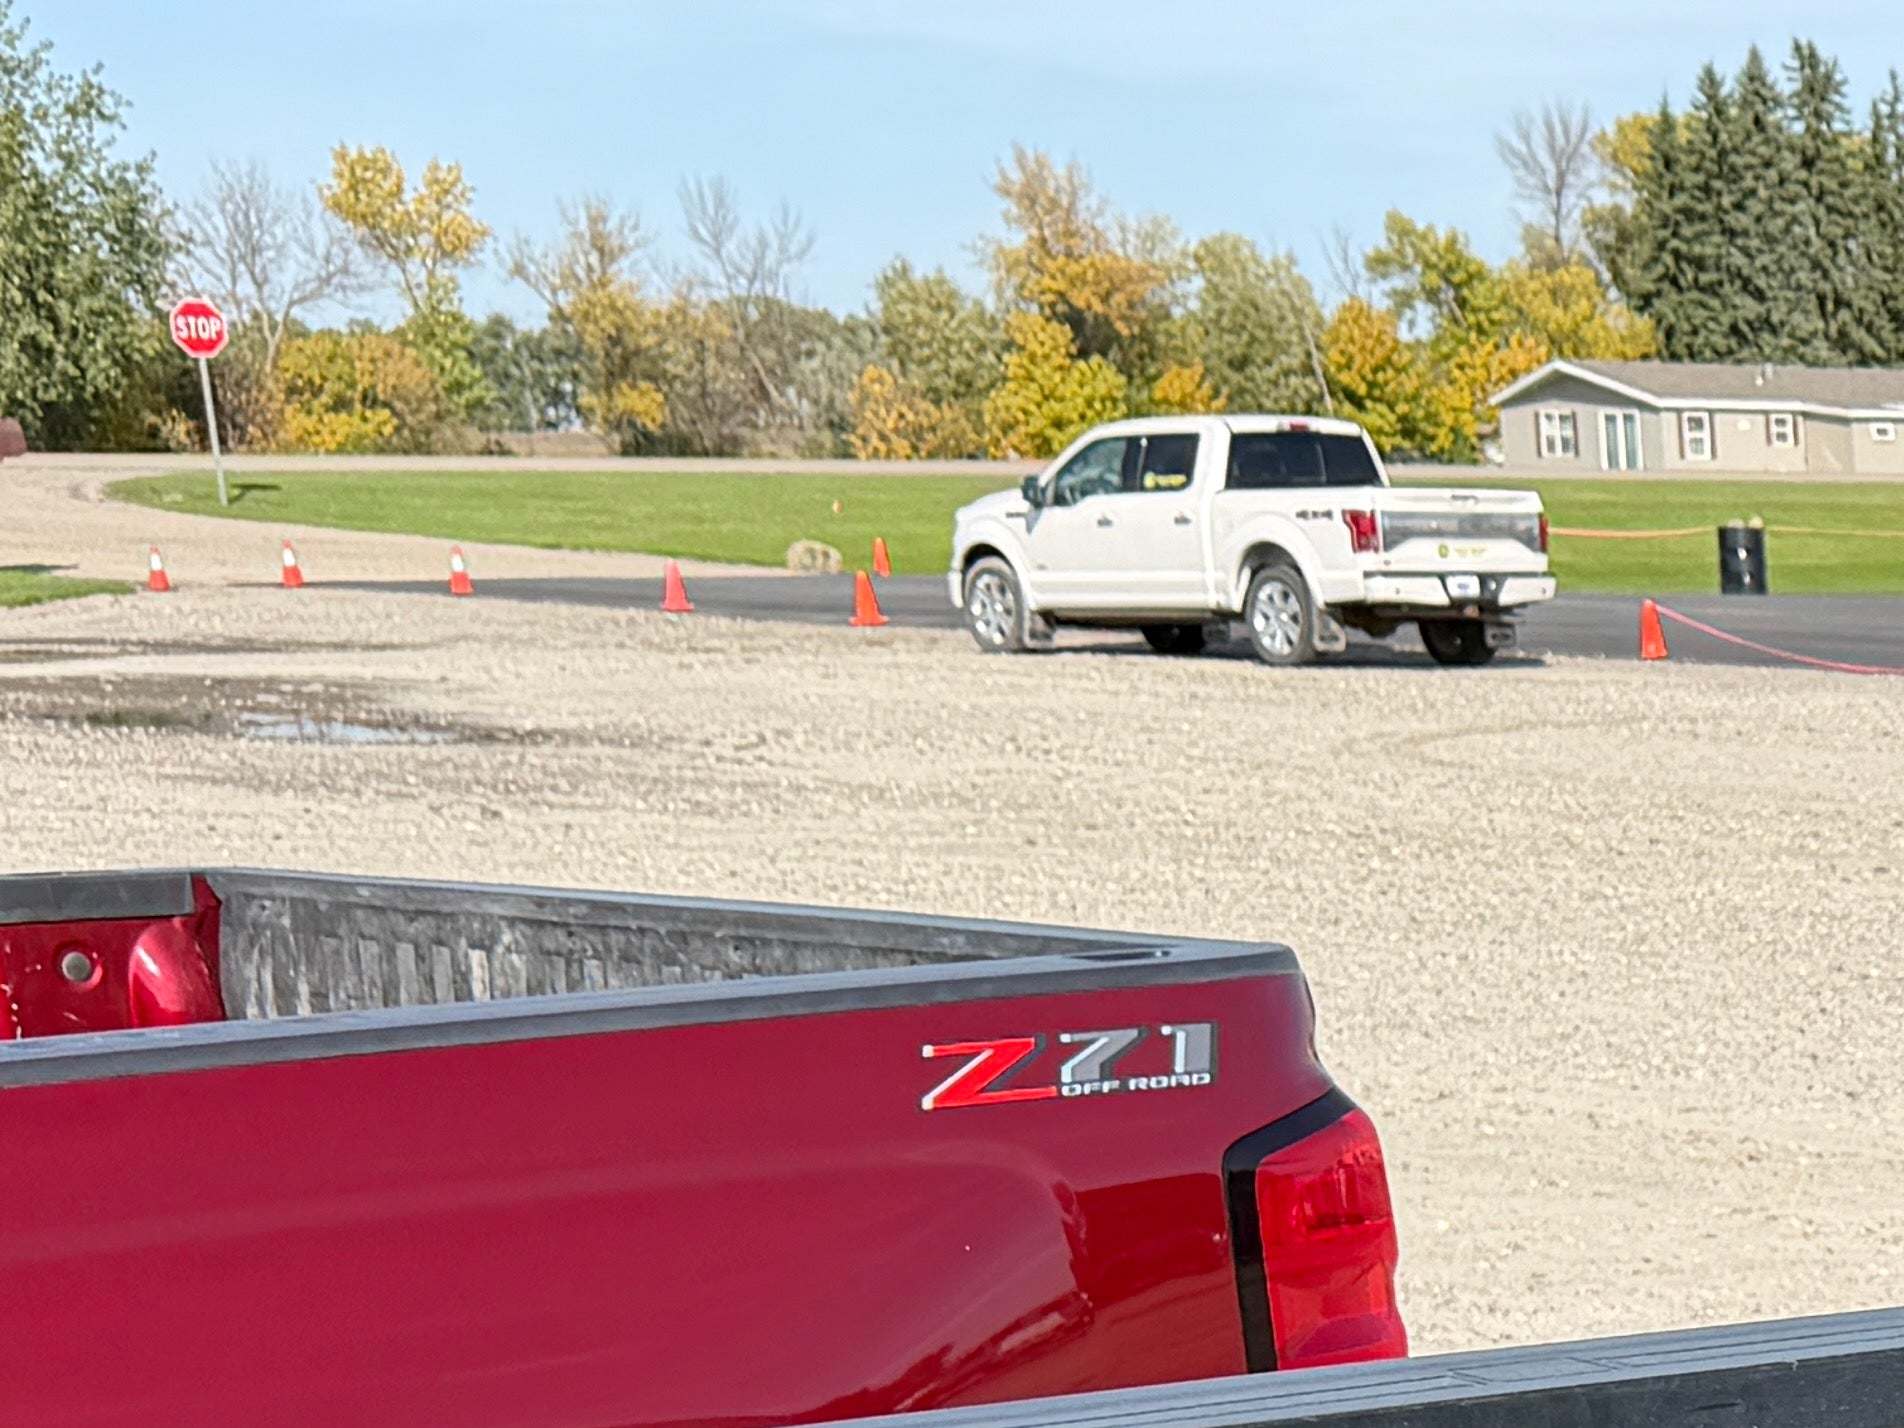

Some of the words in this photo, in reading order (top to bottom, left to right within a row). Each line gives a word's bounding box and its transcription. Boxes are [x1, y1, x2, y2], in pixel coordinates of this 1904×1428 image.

[175, 315, 222, 340] STOP
[921, 1021, 1217, 1111] Z71
[1061, 1079, 1120, 1097] OFF
[1128, 1072, 1211, 1091] ROAD
